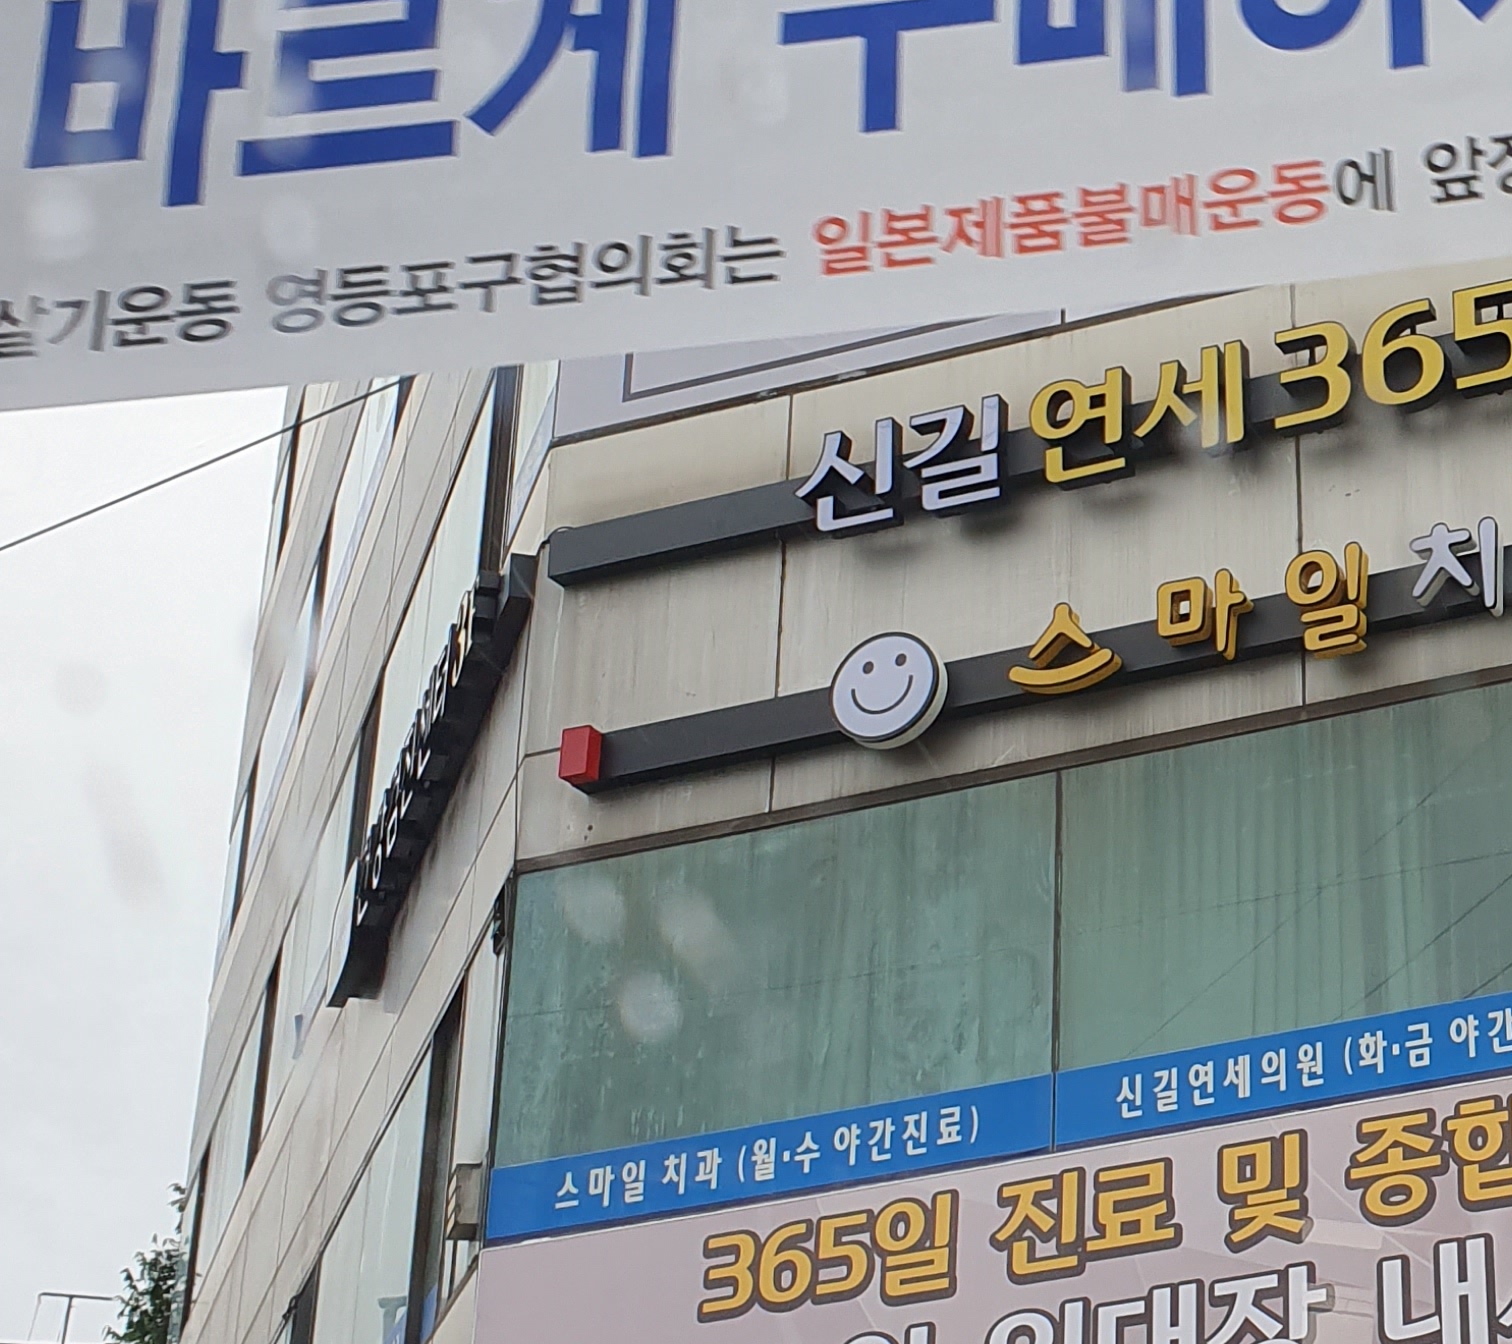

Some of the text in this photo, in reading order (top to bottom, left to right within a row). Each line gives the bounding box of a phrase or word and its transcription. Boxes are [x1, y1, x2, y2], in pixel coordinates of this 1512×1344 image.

[265, 226, 785, 334] 영등포구협의회는
[812, 147, 1396, 276] 일본제품불매운동에
[1116, 1041, 1324, 1119] 신길연세의원
[554, 1159, 646, 1210] 스마일
[661, 1148, 723, 1196] 치과
[833, 1104, 981, 1167] 야간진료)
[697, 1189, 959, 1323] 365일
[988, 1156, 1183, 1286] 진료
[1217, 1129, 1313, 1253] 및
